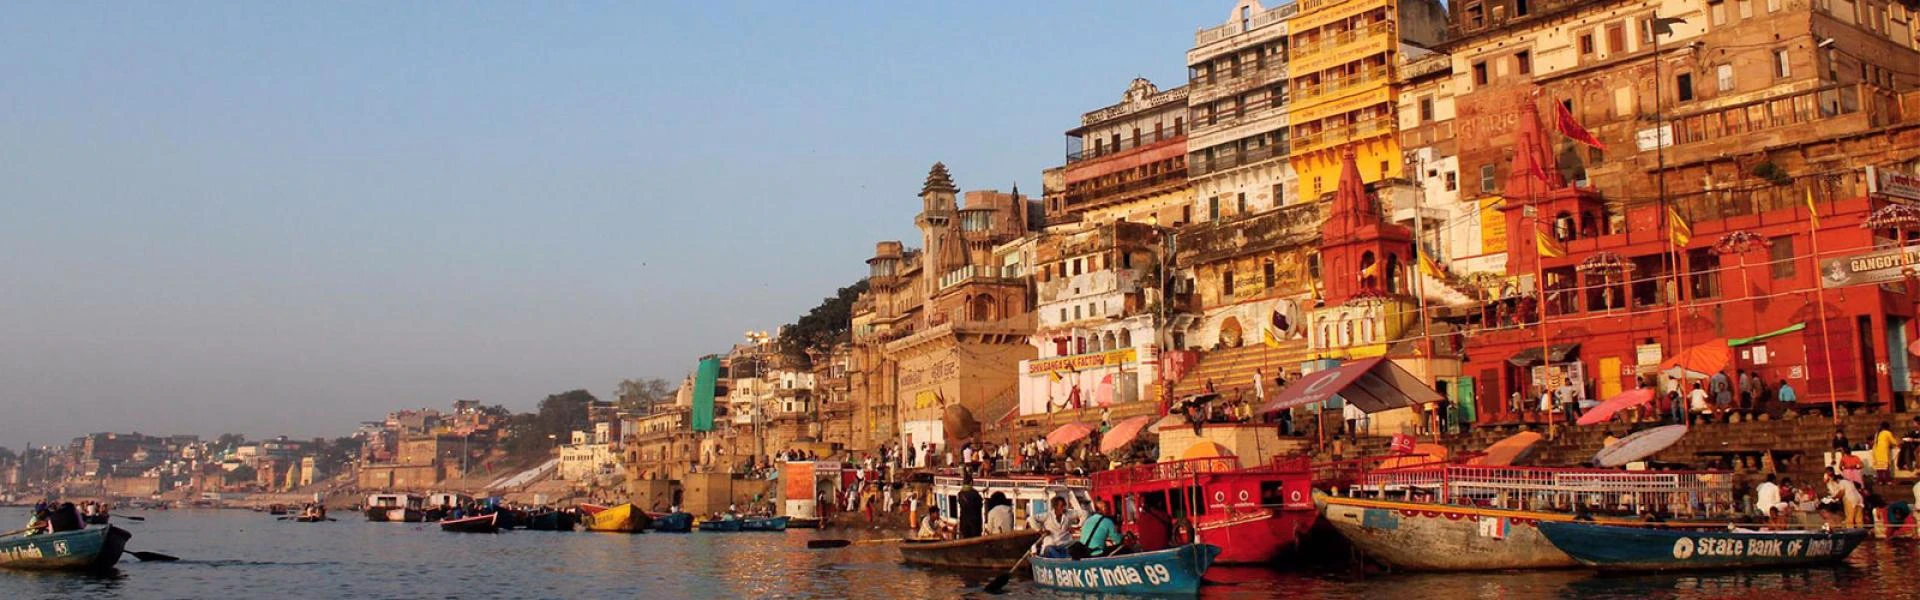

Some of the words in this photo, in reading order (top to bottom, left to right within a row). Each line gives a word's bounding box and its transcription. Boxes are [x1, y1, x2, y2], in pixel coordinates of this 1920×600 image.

[1078, 354, 1106, 368] FACTORY
[1698, 537, 1743, 556] State
[1747, 538, 1782, 556] Bank
[1055, 567, 1085, 588] Bank
[1099, 565, 1143, 587] India
[1144, 563, 1171, 586] 89
